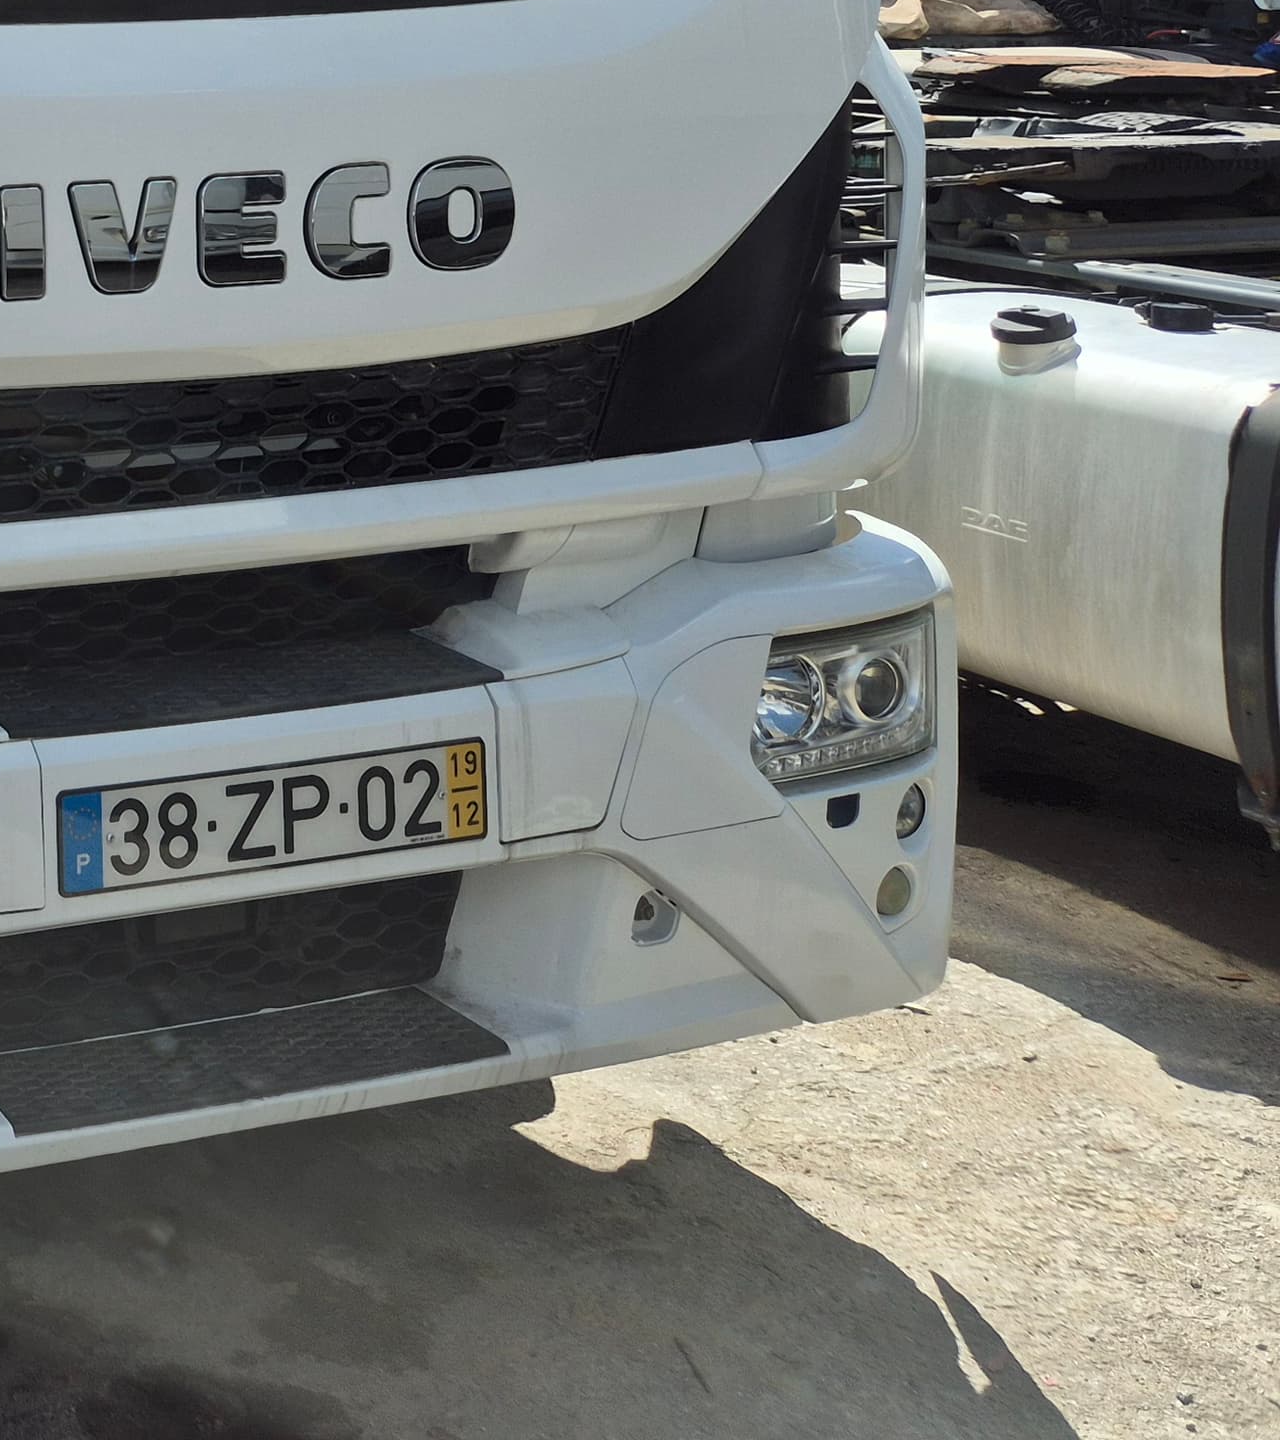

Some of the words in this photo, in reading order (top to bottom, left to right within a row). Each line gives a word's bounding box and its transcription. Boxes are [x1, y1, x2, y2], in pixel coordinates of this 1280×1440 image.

[450, 750, 478, 778] 19
[452, 800, 480, 828] 12
[76, 852, 91, 875] P
